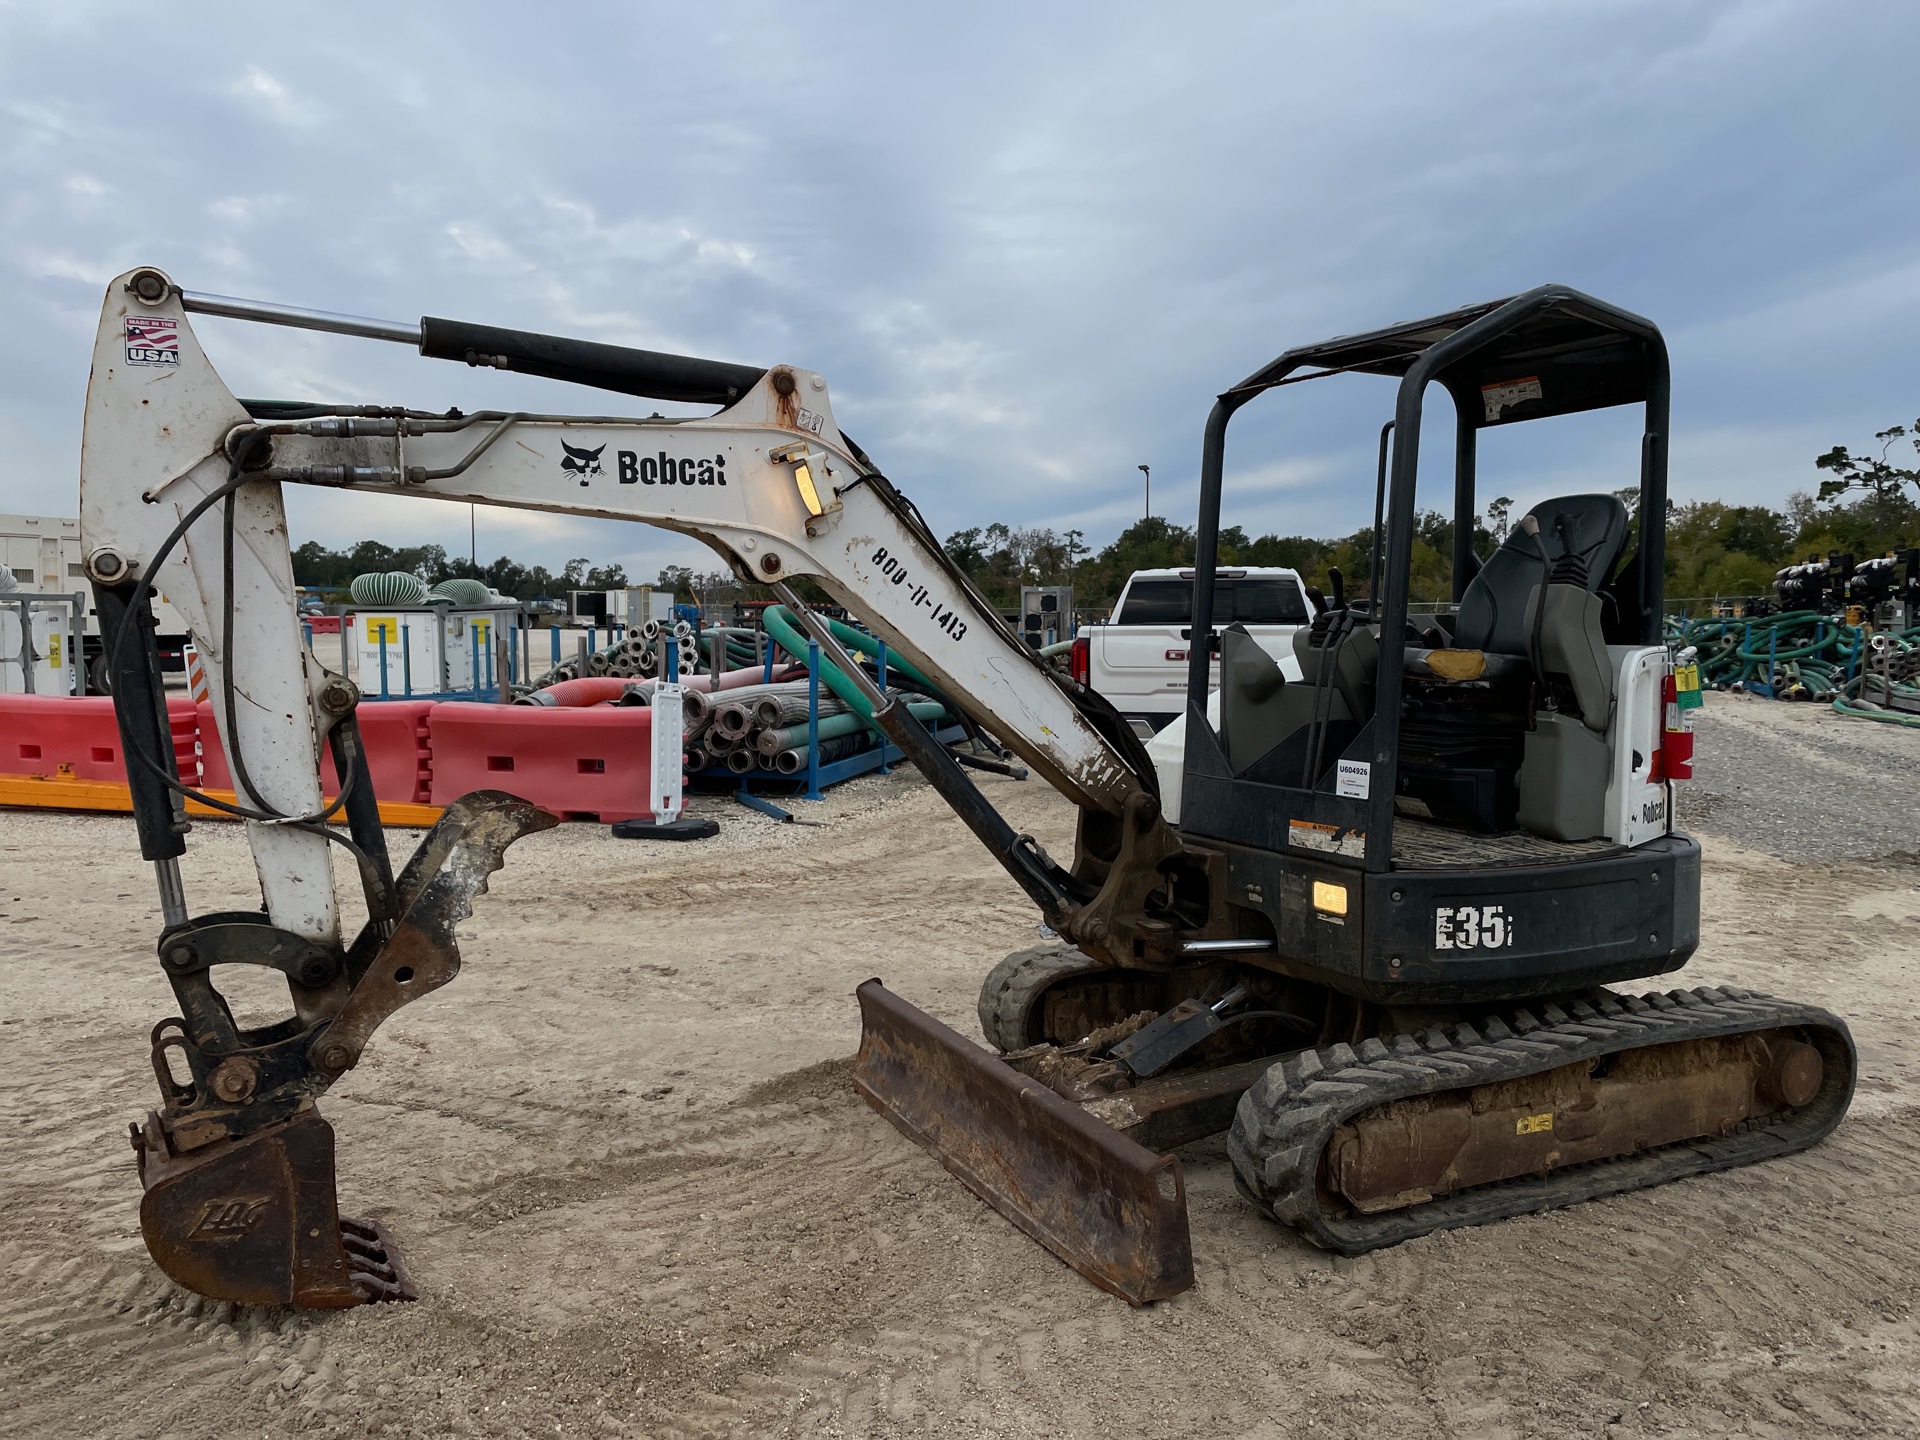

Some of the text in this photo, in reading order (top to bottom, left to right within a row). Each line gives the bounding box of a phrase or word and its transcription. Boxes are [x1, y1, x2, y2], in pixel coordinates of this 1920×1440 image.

[130, 349, 176, 363] USA
[617, 450, 727, 486] Bobcat
[1339, 765, 1368, 776] U604926
[1642, 797, 1665, 824] Bobcat
